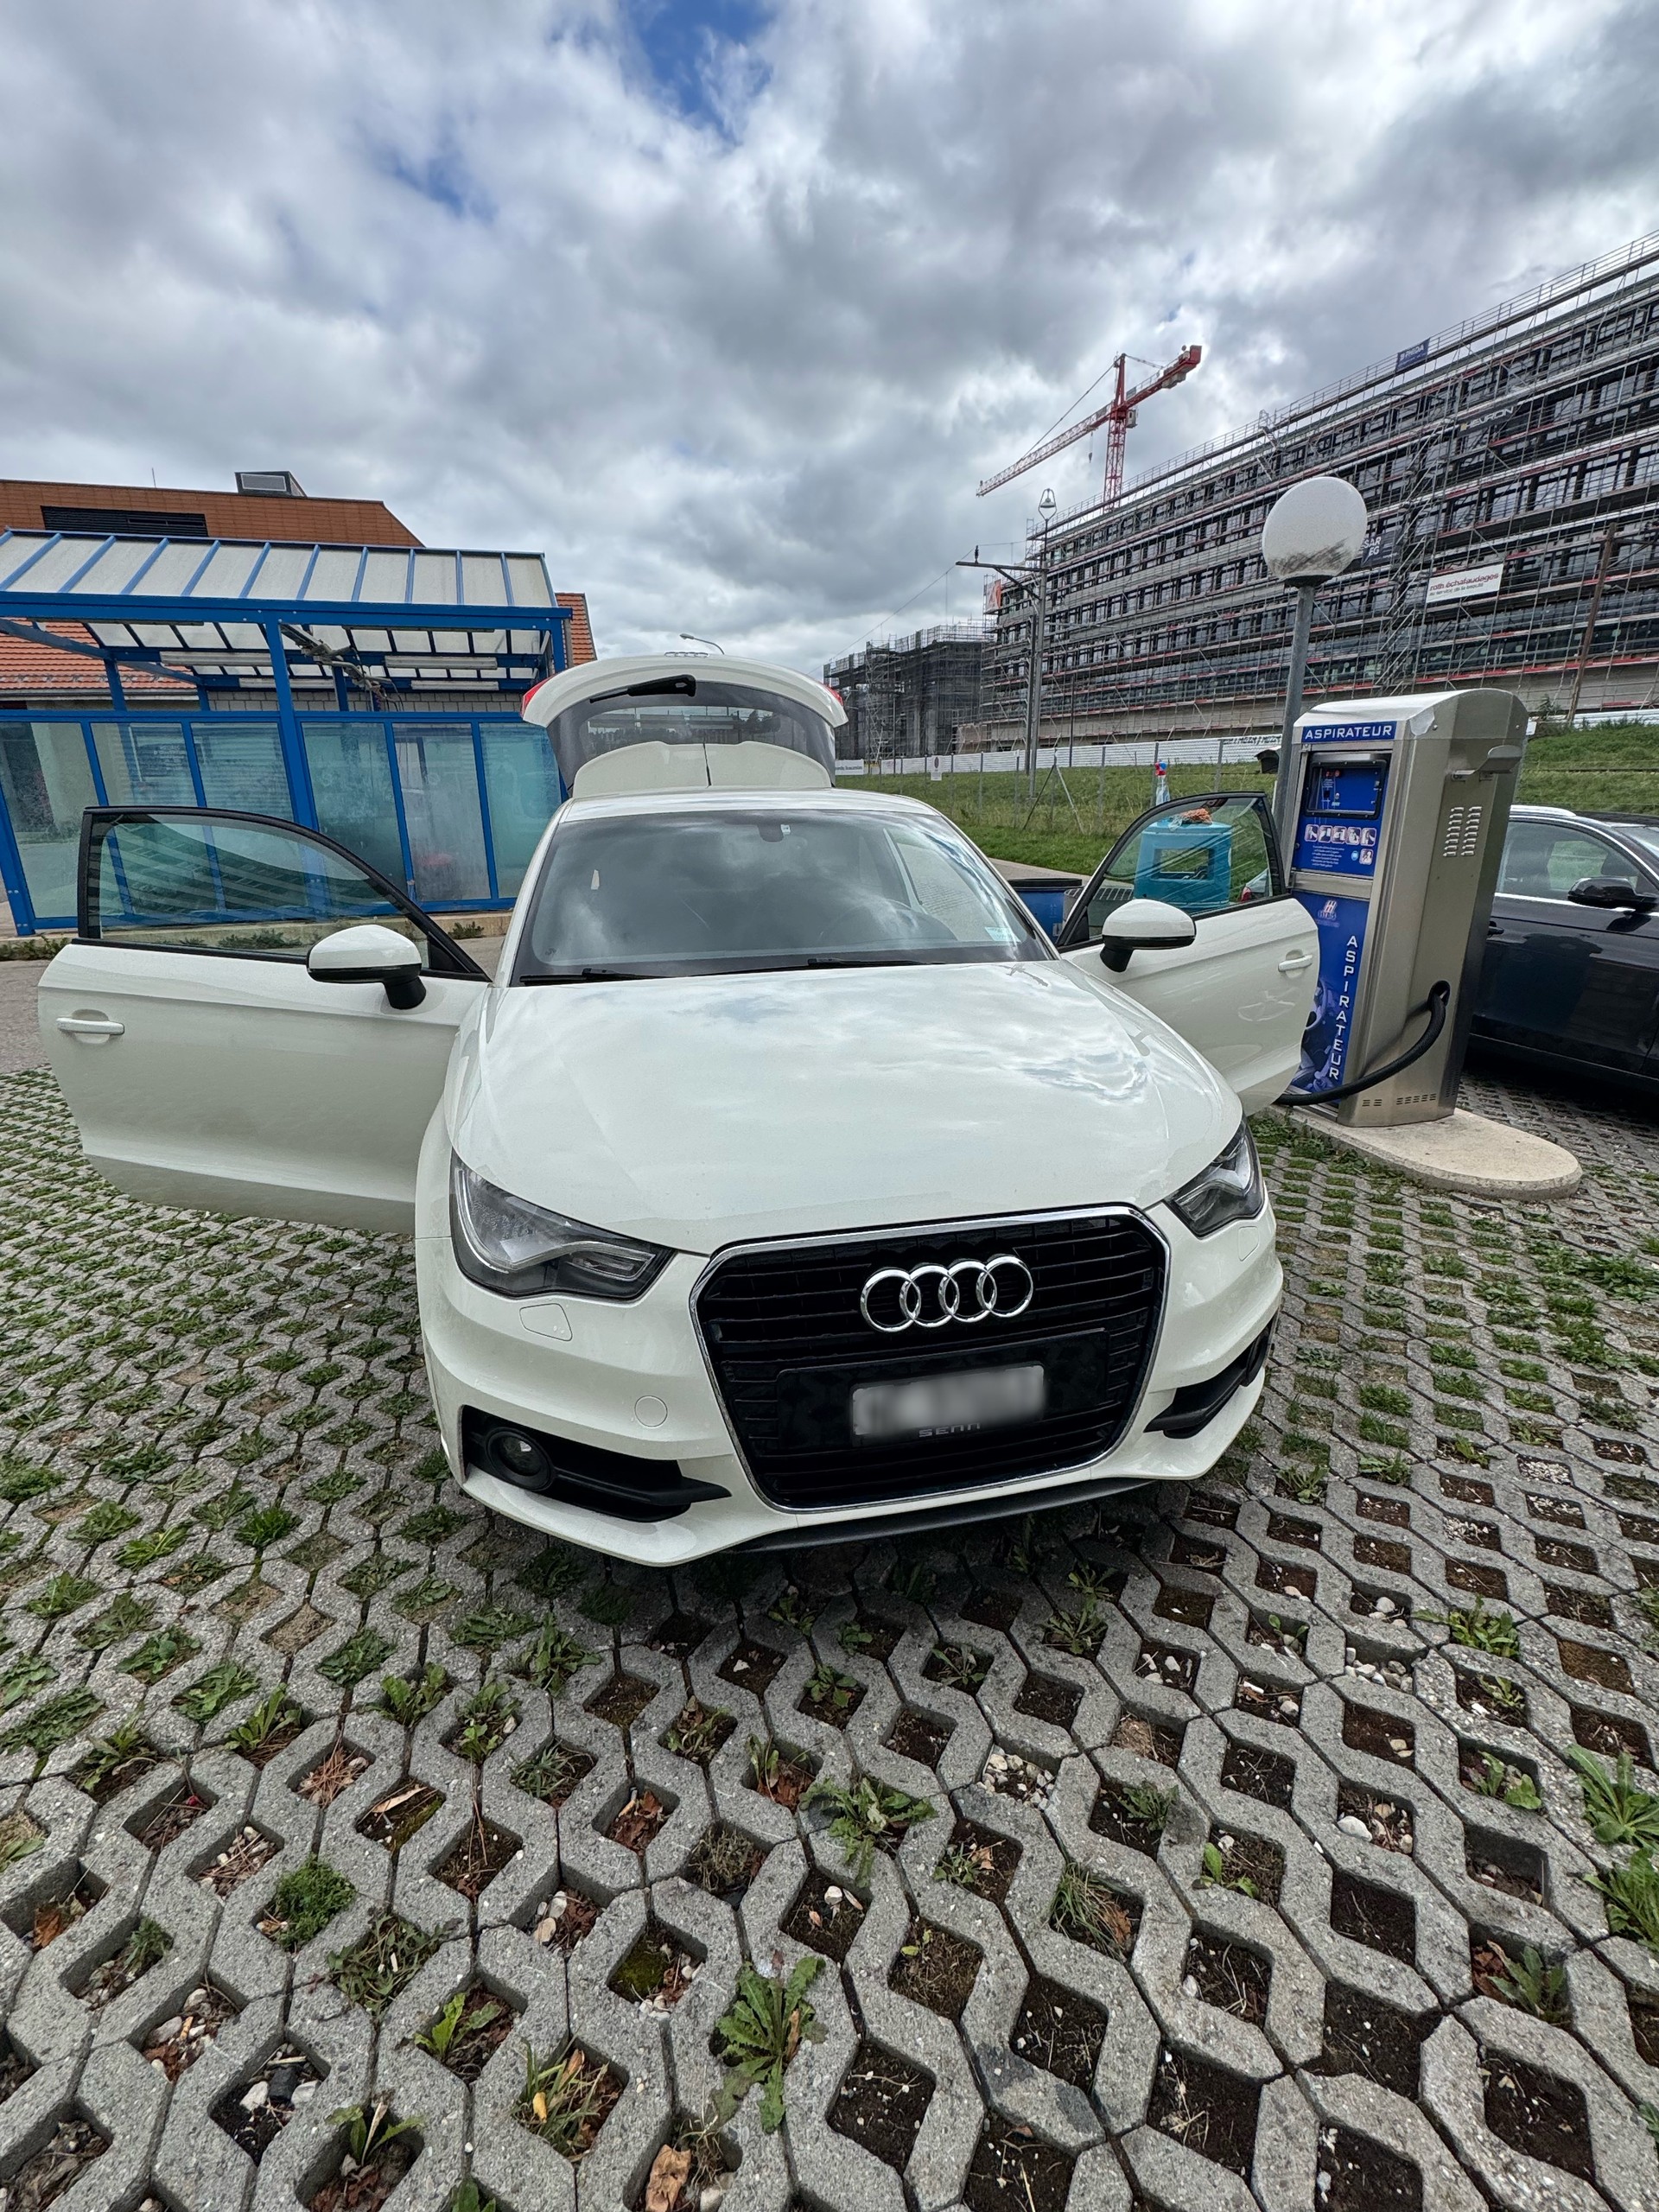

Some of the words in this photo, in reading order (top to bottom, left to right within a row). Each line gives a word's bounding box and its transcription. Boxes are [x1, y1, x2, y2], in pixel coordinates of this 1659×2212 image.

[1429, 582, 1444, 591] roth
[1305, 726, 1392, 740] ASPIRATEUR
[1329, 935, 1358, 1080] ASPIRATEUR
